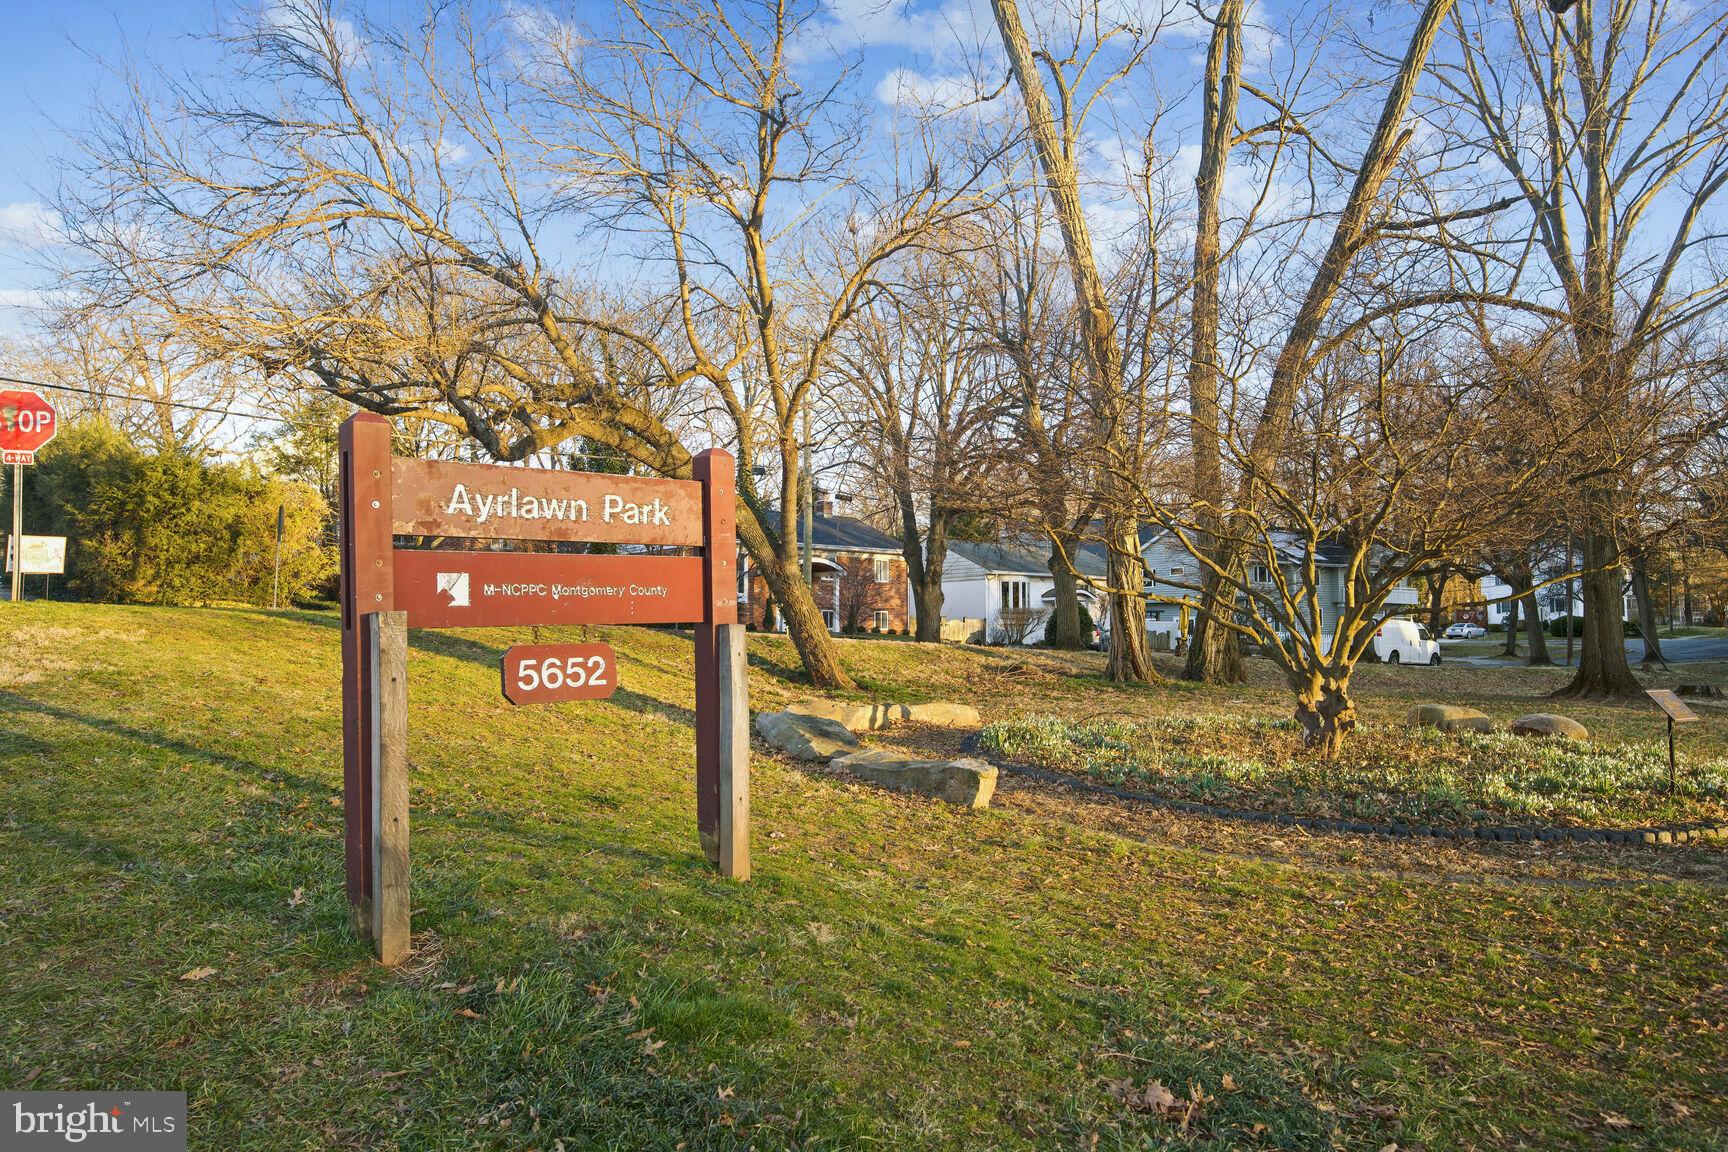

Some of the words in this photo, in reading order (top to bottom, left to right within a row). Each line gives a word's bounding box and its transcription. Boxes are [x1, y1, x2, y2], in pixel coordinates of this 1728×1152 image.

[0, 409, 51, 433] TOP
[5, 453, 32, 463] 4-WAY
[447, 484, 588, 523] Ayrlawn
[603, 495, 671, 526] Park
[483, 584, 547, 596] M-NCPPC
[552, 584, 626, 598] Montgomery
[629, 584, 668, 597] County
[517, 656, 608, 691] 5652
